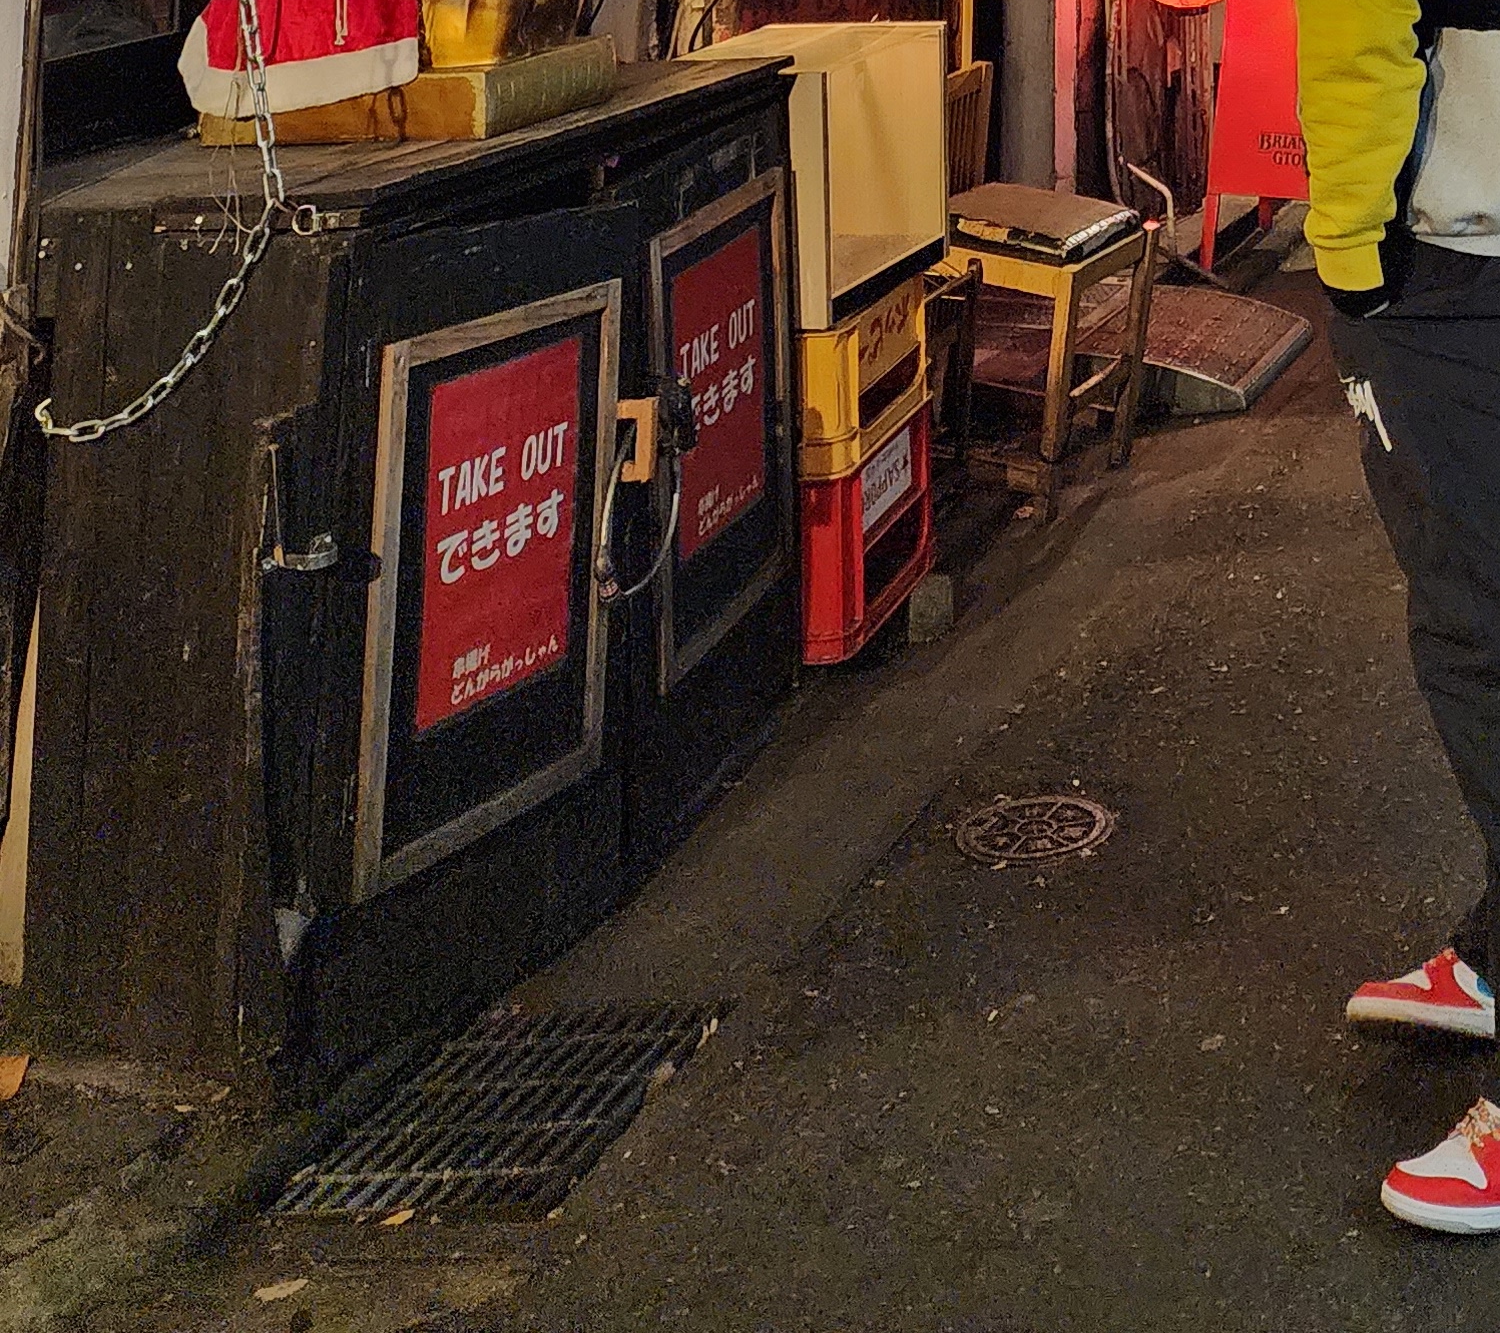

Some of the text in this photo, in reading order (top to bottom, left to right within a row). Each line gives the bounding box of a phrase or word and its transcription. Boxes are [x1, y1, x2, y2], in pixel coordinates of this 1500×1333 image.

[680, 298, 756, 379] TAKE OUT
[437, 421, 569, 516] TAKE OUT
[436, 489, 566, 585] できます
